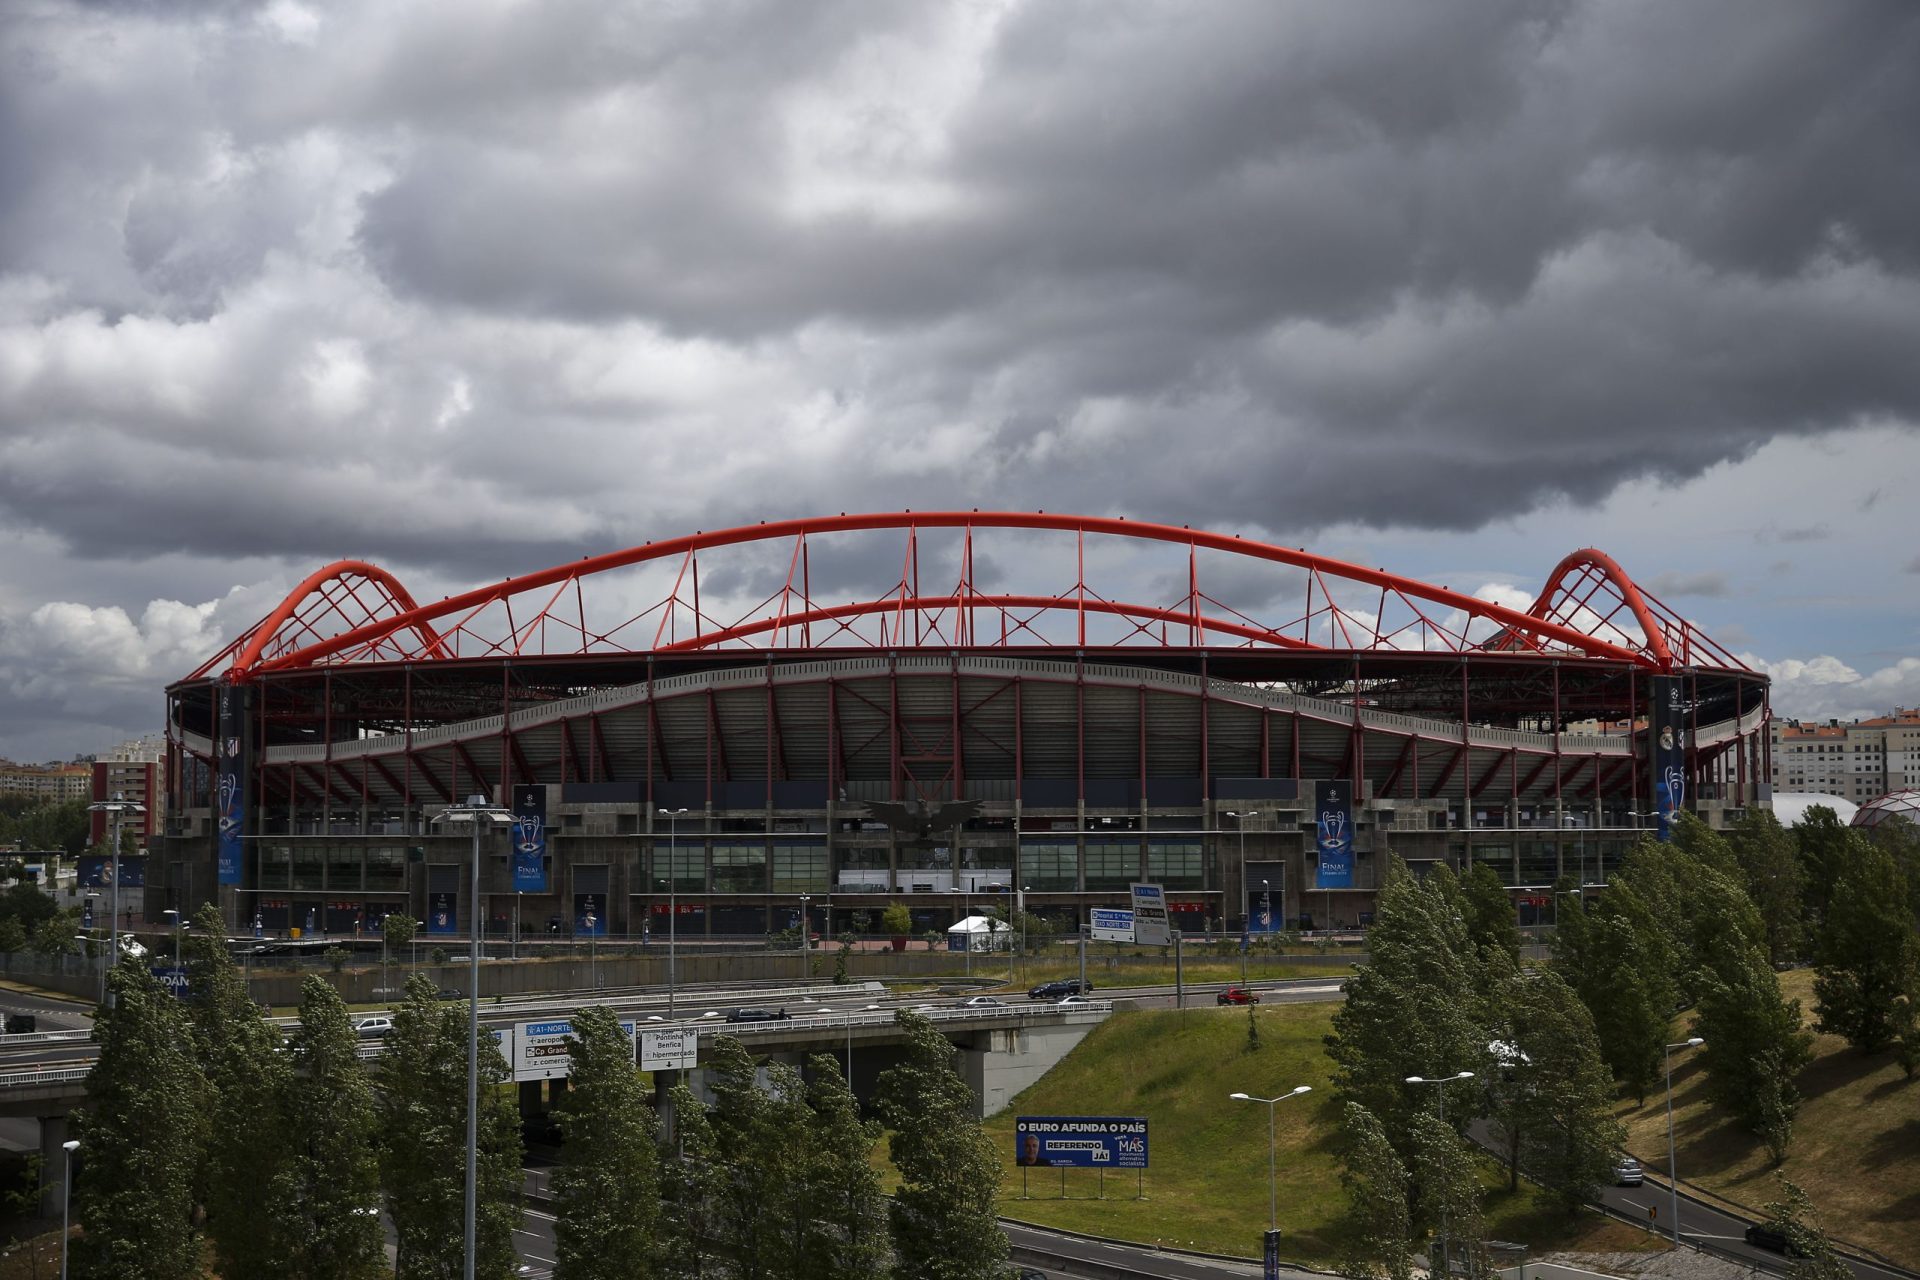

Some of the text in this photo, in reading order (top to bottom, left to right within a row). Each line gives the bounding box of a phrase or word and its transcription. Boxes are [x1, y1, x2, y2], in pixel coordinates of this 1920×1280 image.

[1322, 862, 1345, 871] FINAL
[547, 1046, 568, 1054] Grand
[652, 1050, 695, 1059] hipermercado
[1018, 1122, 1146, 1133] O EURO AFUNDA O PAÍS
[1094, 1151, 1108, 1160] JÁ!
